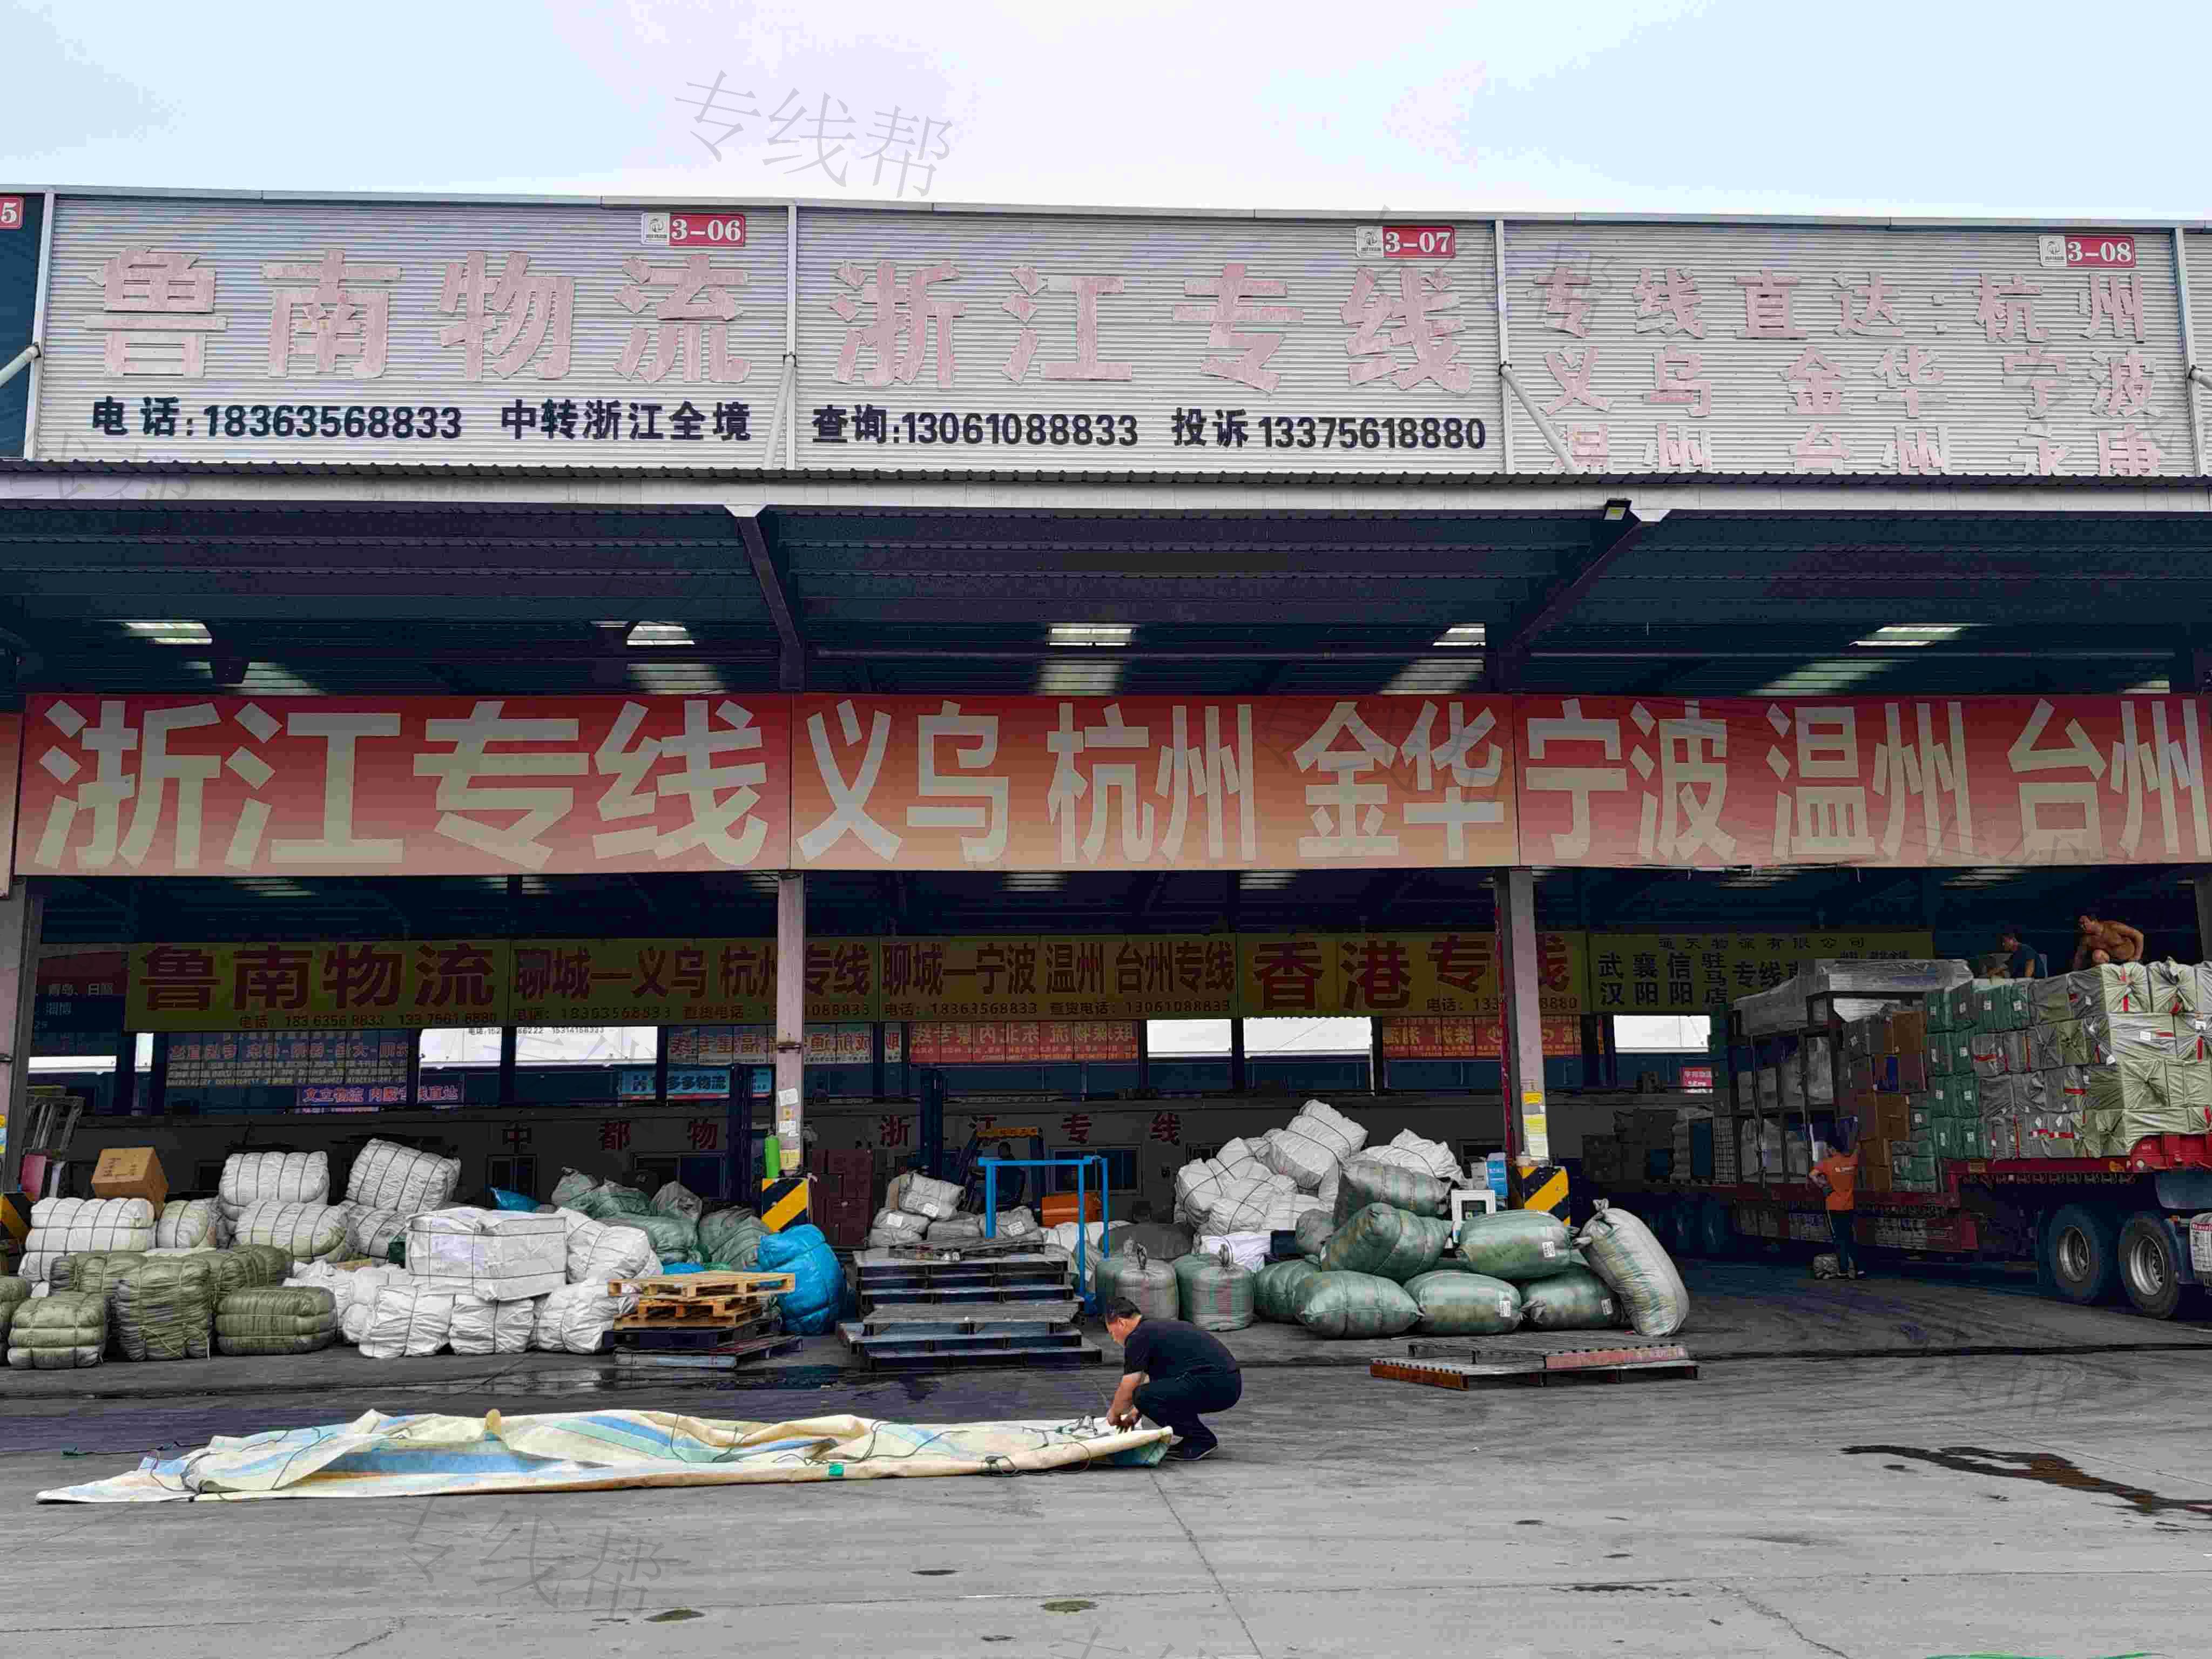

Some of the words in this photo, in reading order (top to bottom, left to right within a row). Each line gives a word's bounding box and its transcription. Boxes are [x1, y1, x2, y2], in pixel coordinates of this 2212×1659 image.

[671, 219, 741, 241] 3-06
[1385, 232, 1452, 253] 3-07
[2067, 241, 2132, 264] 3-08
[84, 246, 751, 383] 鲁南物流
[828, 260, 1474, 395] 浙江专线
[1540, 346, 1711, 417] 义乌
[1781, 345, 1947, 418] 金华
[2002, 345, 2160, 418] 宁波
[501, 399, 751, 441] 中转浙江全境
[33, 699, 768, 868] 浙江专线
[796, 699, 1009, 863] 义乌
[1047, 702, 1258, 863] 杭州
[1293, 700, 1504, 861] 金华
[1525, 697, 1737, 861] 宁波
[1766, 702, 1974, 859] 温州
[2006, 698, 2212, 858] 台州
[139, 943, 495, 1010] 鲁南物流
[1046, 942, 1104, 994] 温州
[1116, 941, 1235, 994] 台州专线
